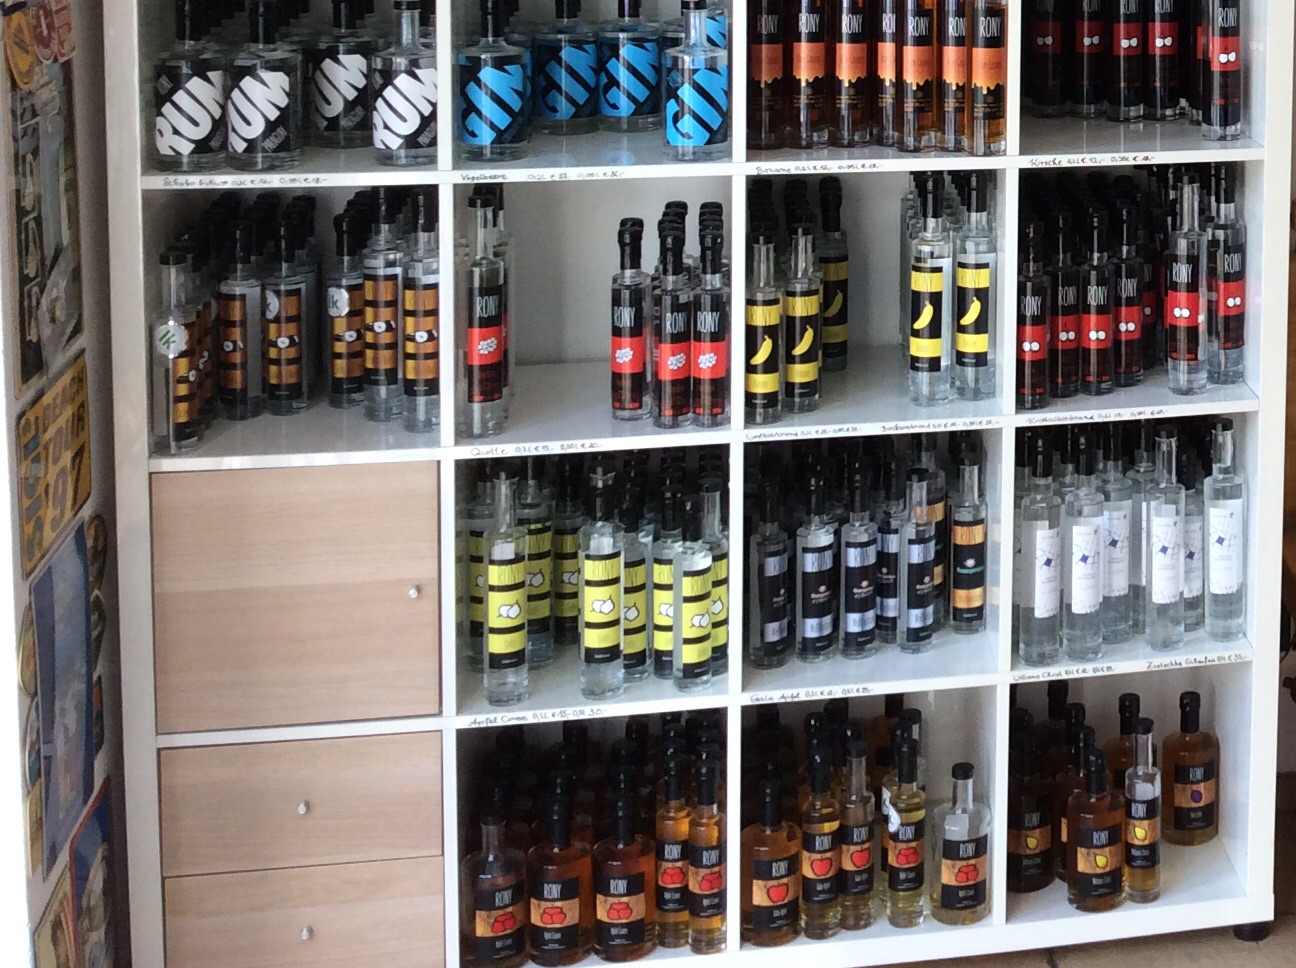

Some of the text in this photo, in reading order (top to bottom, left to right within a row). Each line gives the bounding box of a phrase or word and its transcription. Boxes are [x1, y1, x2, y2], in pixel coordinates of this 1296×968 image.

[798, 13, 820, 33] RONY
[842, 13, 863, 34] RONY
[909, 16, 930, 37] RONY
[980, 16, 1001, 38] RONY
[1218, 7, 1238, 28] RONY
[536, 43, 597, 120] GIN
[601, 42, 659, 118] GIN
[461, 64, 523, 146] GIN
[666, 65, 728, 146] GIN
[1172, 262, 1193, 283] RONY
[1224, 253, 1242, 274] RONY
[1058, 286, 1078, 306] RONY
[1087, 285, 1109, 306] RONY
[1117, 278, 1138, 298] RONY
[1021, 295, 1042, 316] RONY
[613, 306, 636, 328] RONY
[697, 311, 720, 333] RONY
